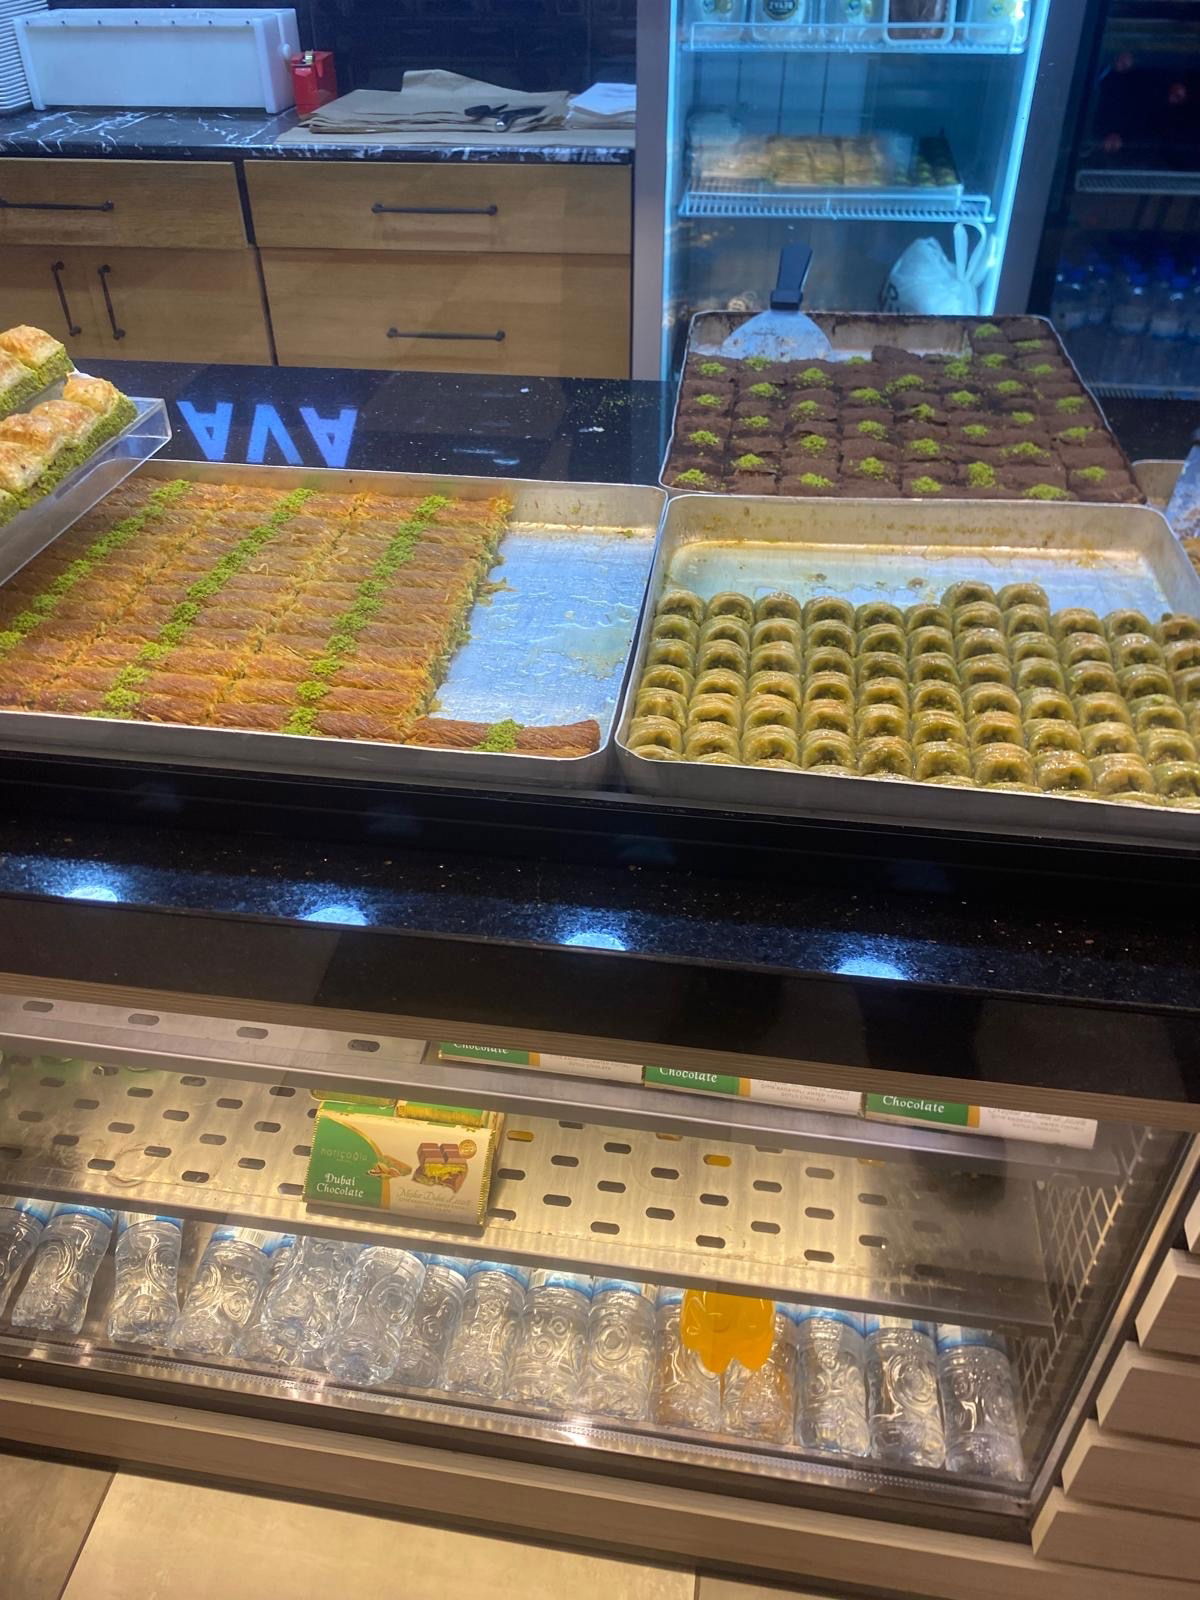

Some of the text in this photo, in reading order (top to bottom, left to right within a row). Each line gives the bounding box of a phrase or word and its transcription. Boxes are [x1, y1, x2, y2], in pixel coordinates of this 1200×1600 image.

[882, 1095, 945, 1113] Chocolate
[324, 1172, 356, 1186] Dubai
[316, 1182, 365, 1198] Chocolate
